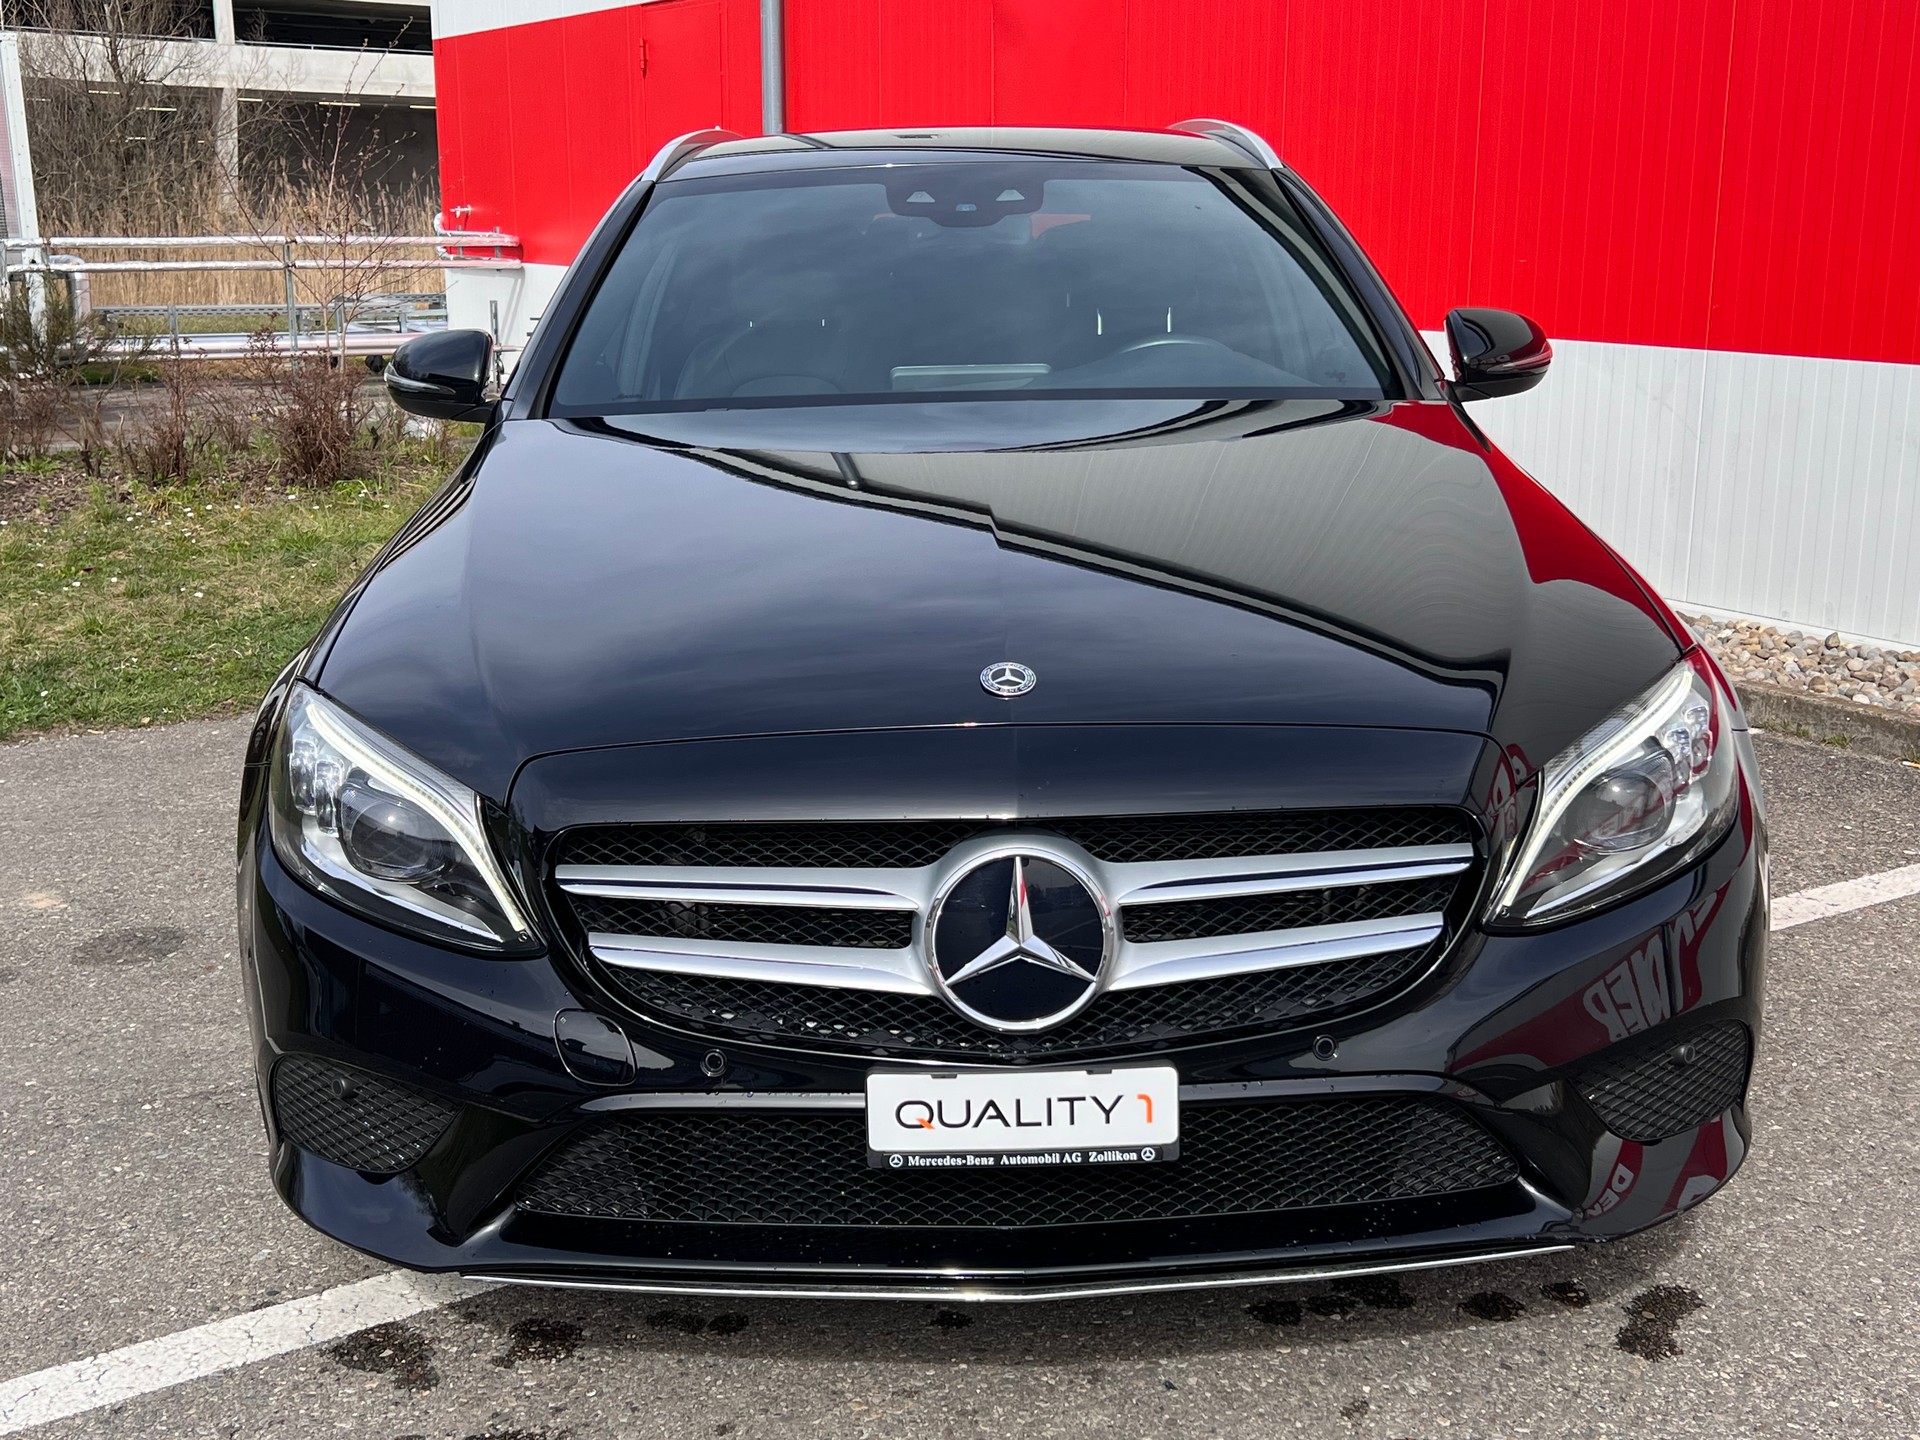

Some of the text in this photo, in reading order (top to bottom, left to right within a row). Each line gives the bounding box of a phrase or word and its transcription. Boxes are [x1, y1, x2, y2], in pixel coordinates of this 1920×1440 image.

[895, 1093, 1153, 1130] QUALITY 1
[907, 1150, 1138, 1167] Mercedes-Benz Automobil AG Zollikon
